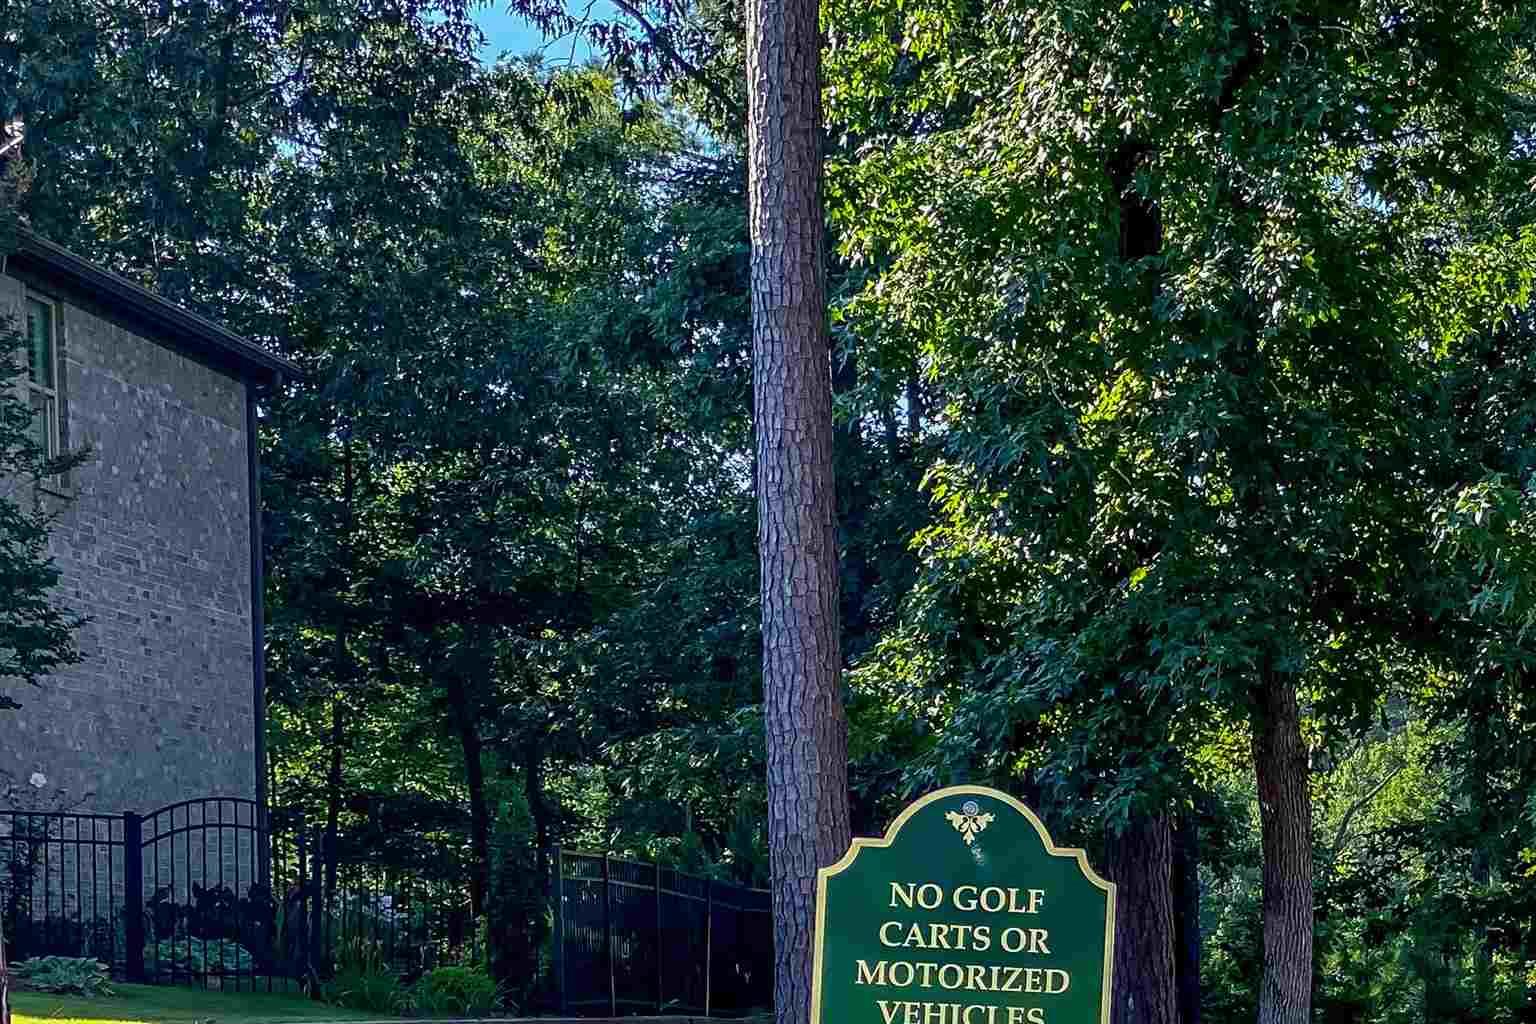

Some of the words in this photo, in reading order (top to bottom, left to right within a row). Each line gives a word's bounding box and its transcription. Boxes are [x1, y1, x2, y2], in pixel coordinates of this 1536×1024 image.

[889, 882, 943, 909] NO
[952, 886, 1045, 914] GOLF
[879, 921, 992, 951] CARTS
[1000, 927, 1051, 954] OR
[854, 959, 1070, 994] MOTORIZED
